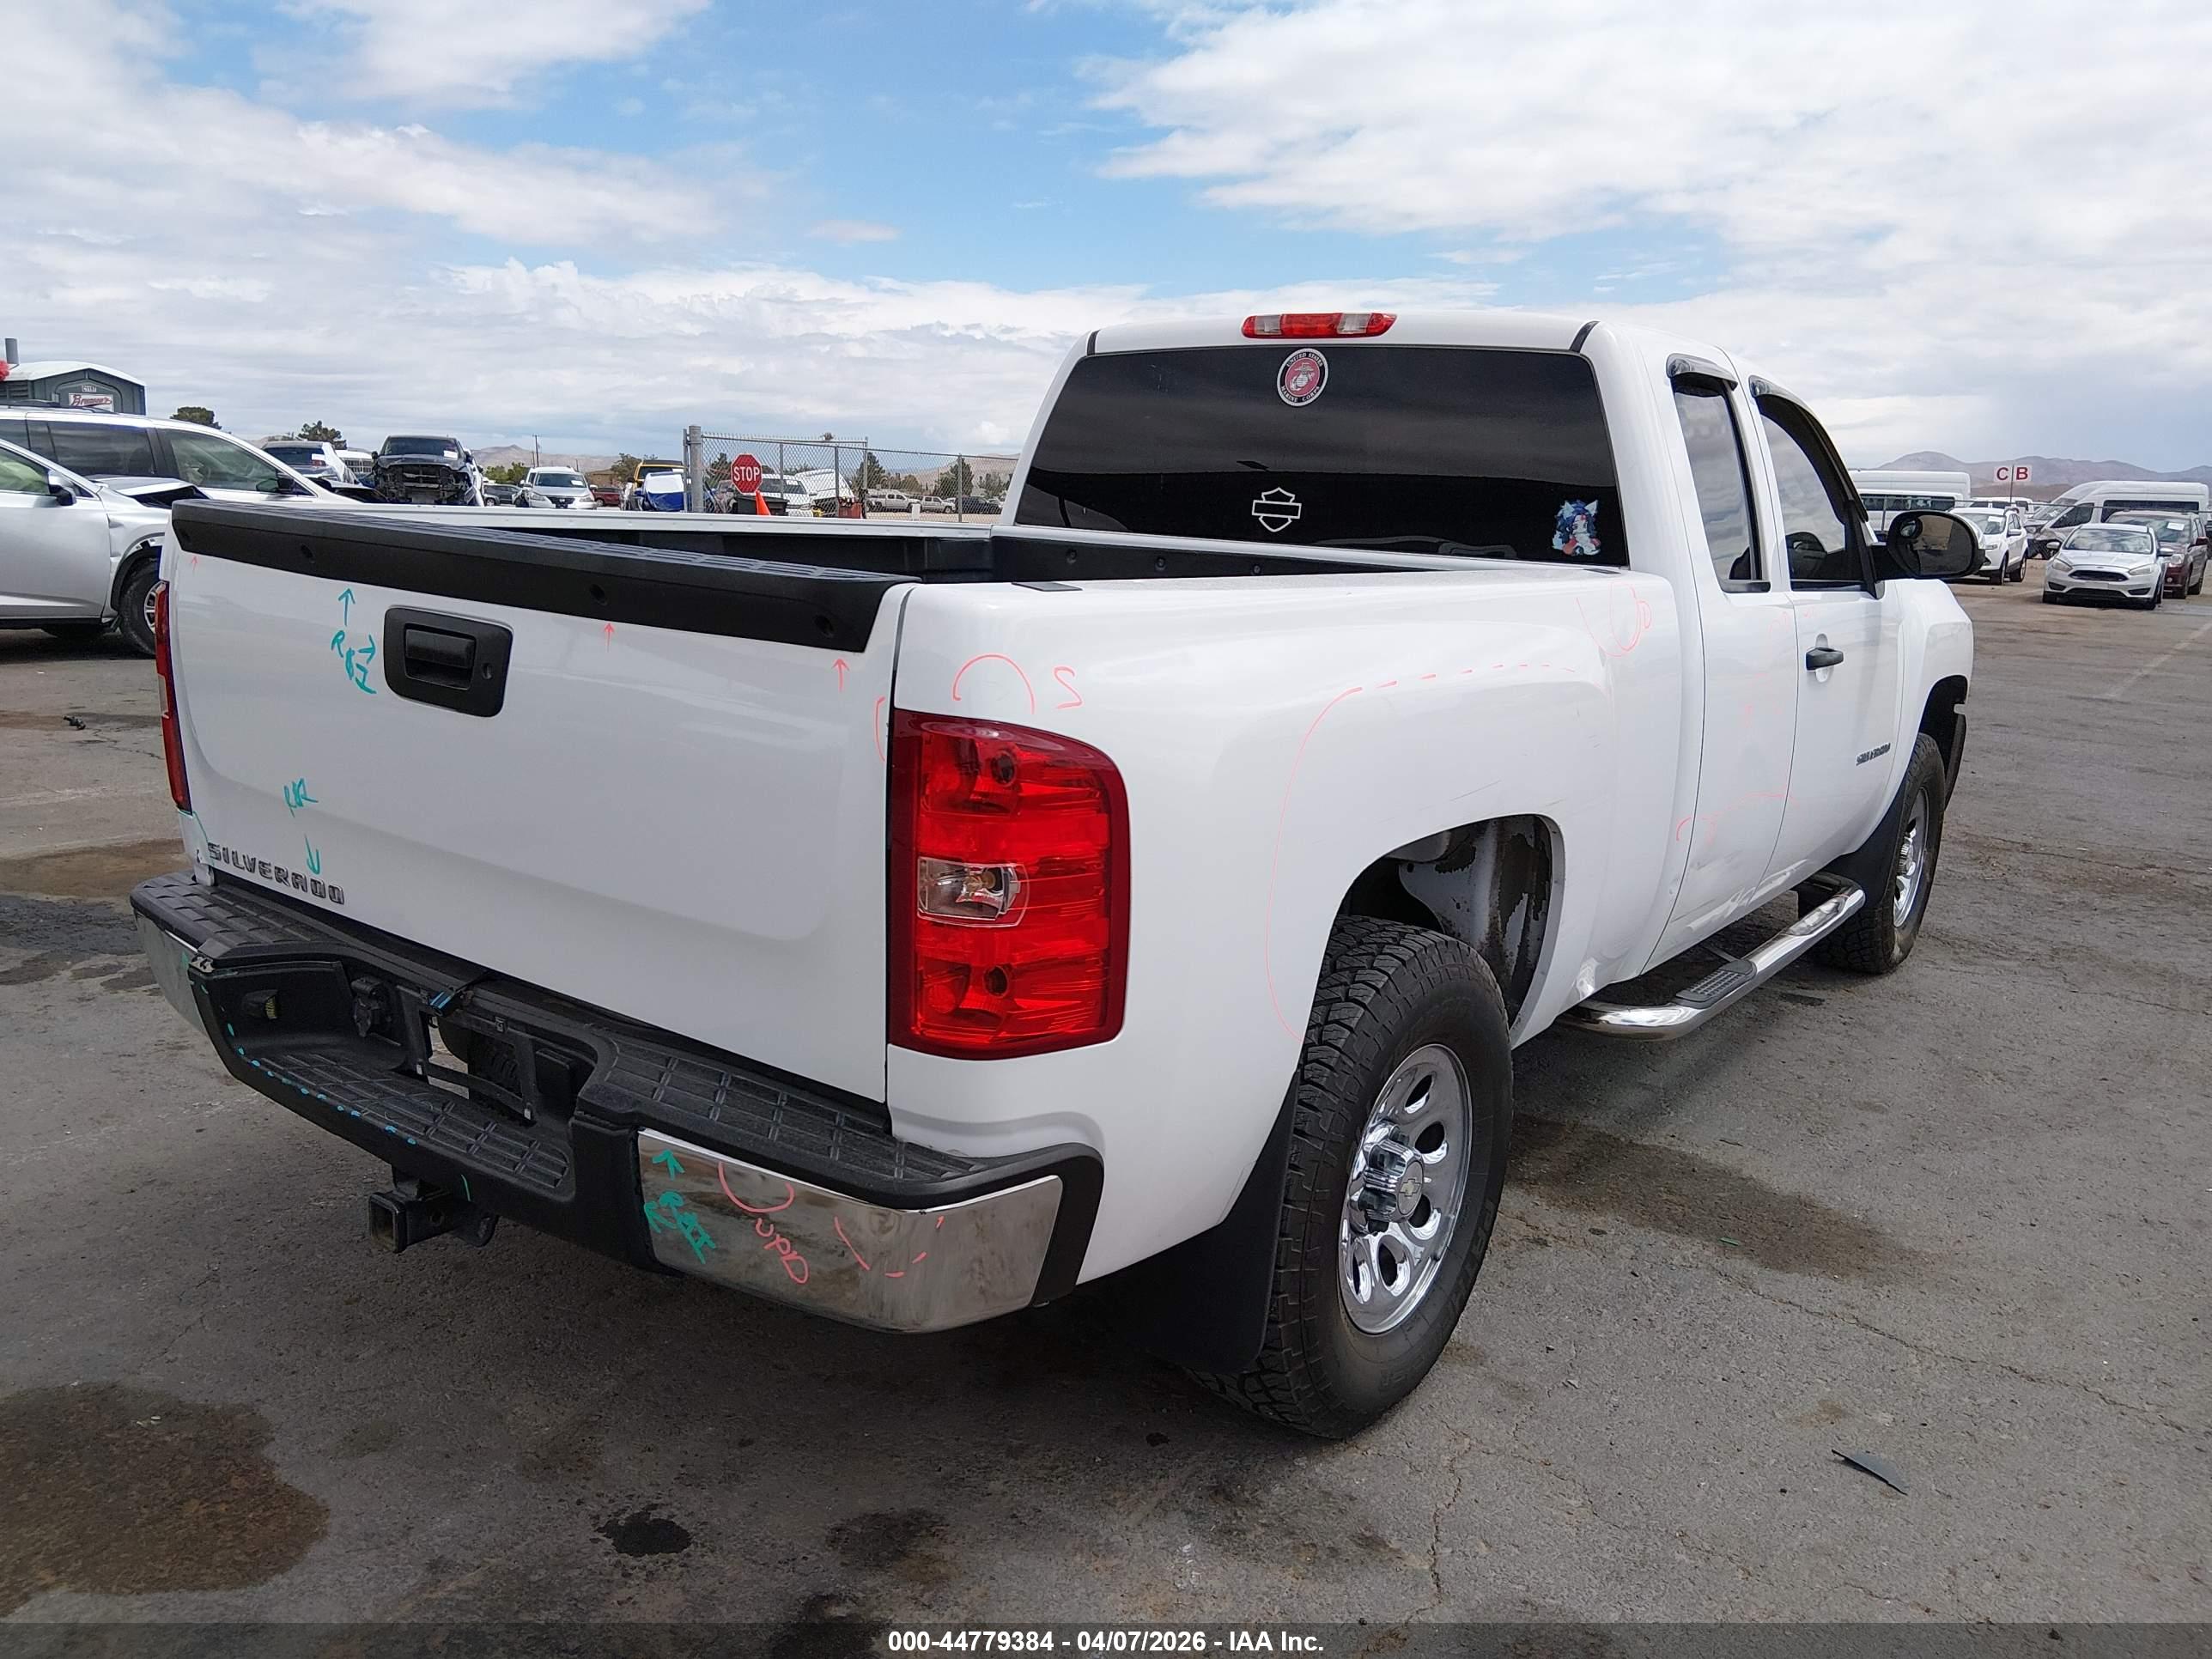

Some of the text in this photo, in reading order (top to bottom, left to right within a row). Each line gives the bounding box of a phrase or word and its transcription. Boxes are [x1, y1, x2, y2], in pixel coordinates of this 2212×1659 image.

[1286, 352, 1323, 368] UNITED STATES
[1281, 385, 1320, 403] MARINE CORPS
[733, 466, 760, 482] STOP
[1996, 466, 2028, 481] C B
[208, 842, 345, 905] SILVERADO
